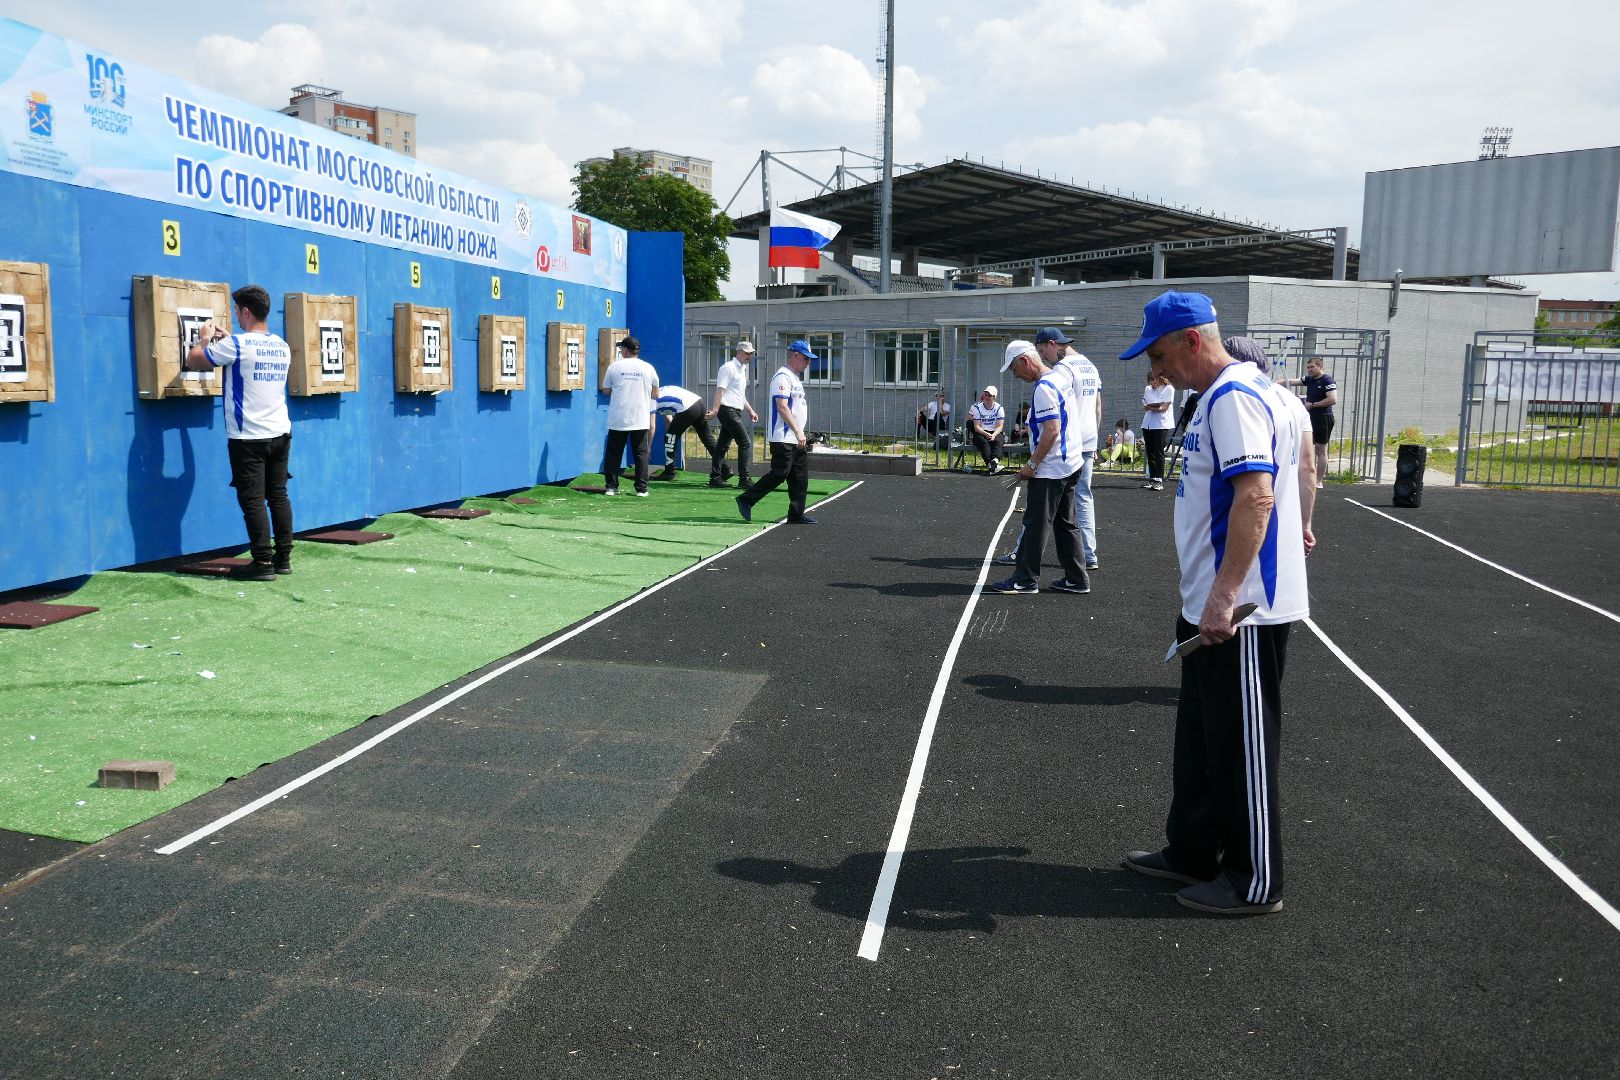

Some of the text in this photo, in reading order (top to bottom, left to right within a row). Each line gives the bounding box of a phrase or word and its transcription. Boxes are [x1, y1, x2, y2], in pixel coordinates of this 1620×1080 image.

[84, 103, 133, 127] МИНСПОРТ
[91, 117, 128, 136] РОССИИ
[165, 96, 310, 171] ЧЕМПИОНАТ
[316, 145, 435, 206] МОСКОВСКОЙ
[438, 183, 500, 224] ОБЛАСТИ
[176, 157, 213, 199] ПО
[220, 168, 376, 233] СПОРТИВНОМУ
[380, 209, 454, 251] МЕТАНИЮ
[457, 228, 498, 260] НОЖА
[165, 224, 178, 251] 3
[308, 248, 318, 270] 4
[413, 265, 420, 284] 5
[493, 279, 499, 296] 6
[557, 292, 563, 307] 7
[256, 348, 287, 358] ОБЛАСТЬ
[664, 432, 677, 466] FILA
